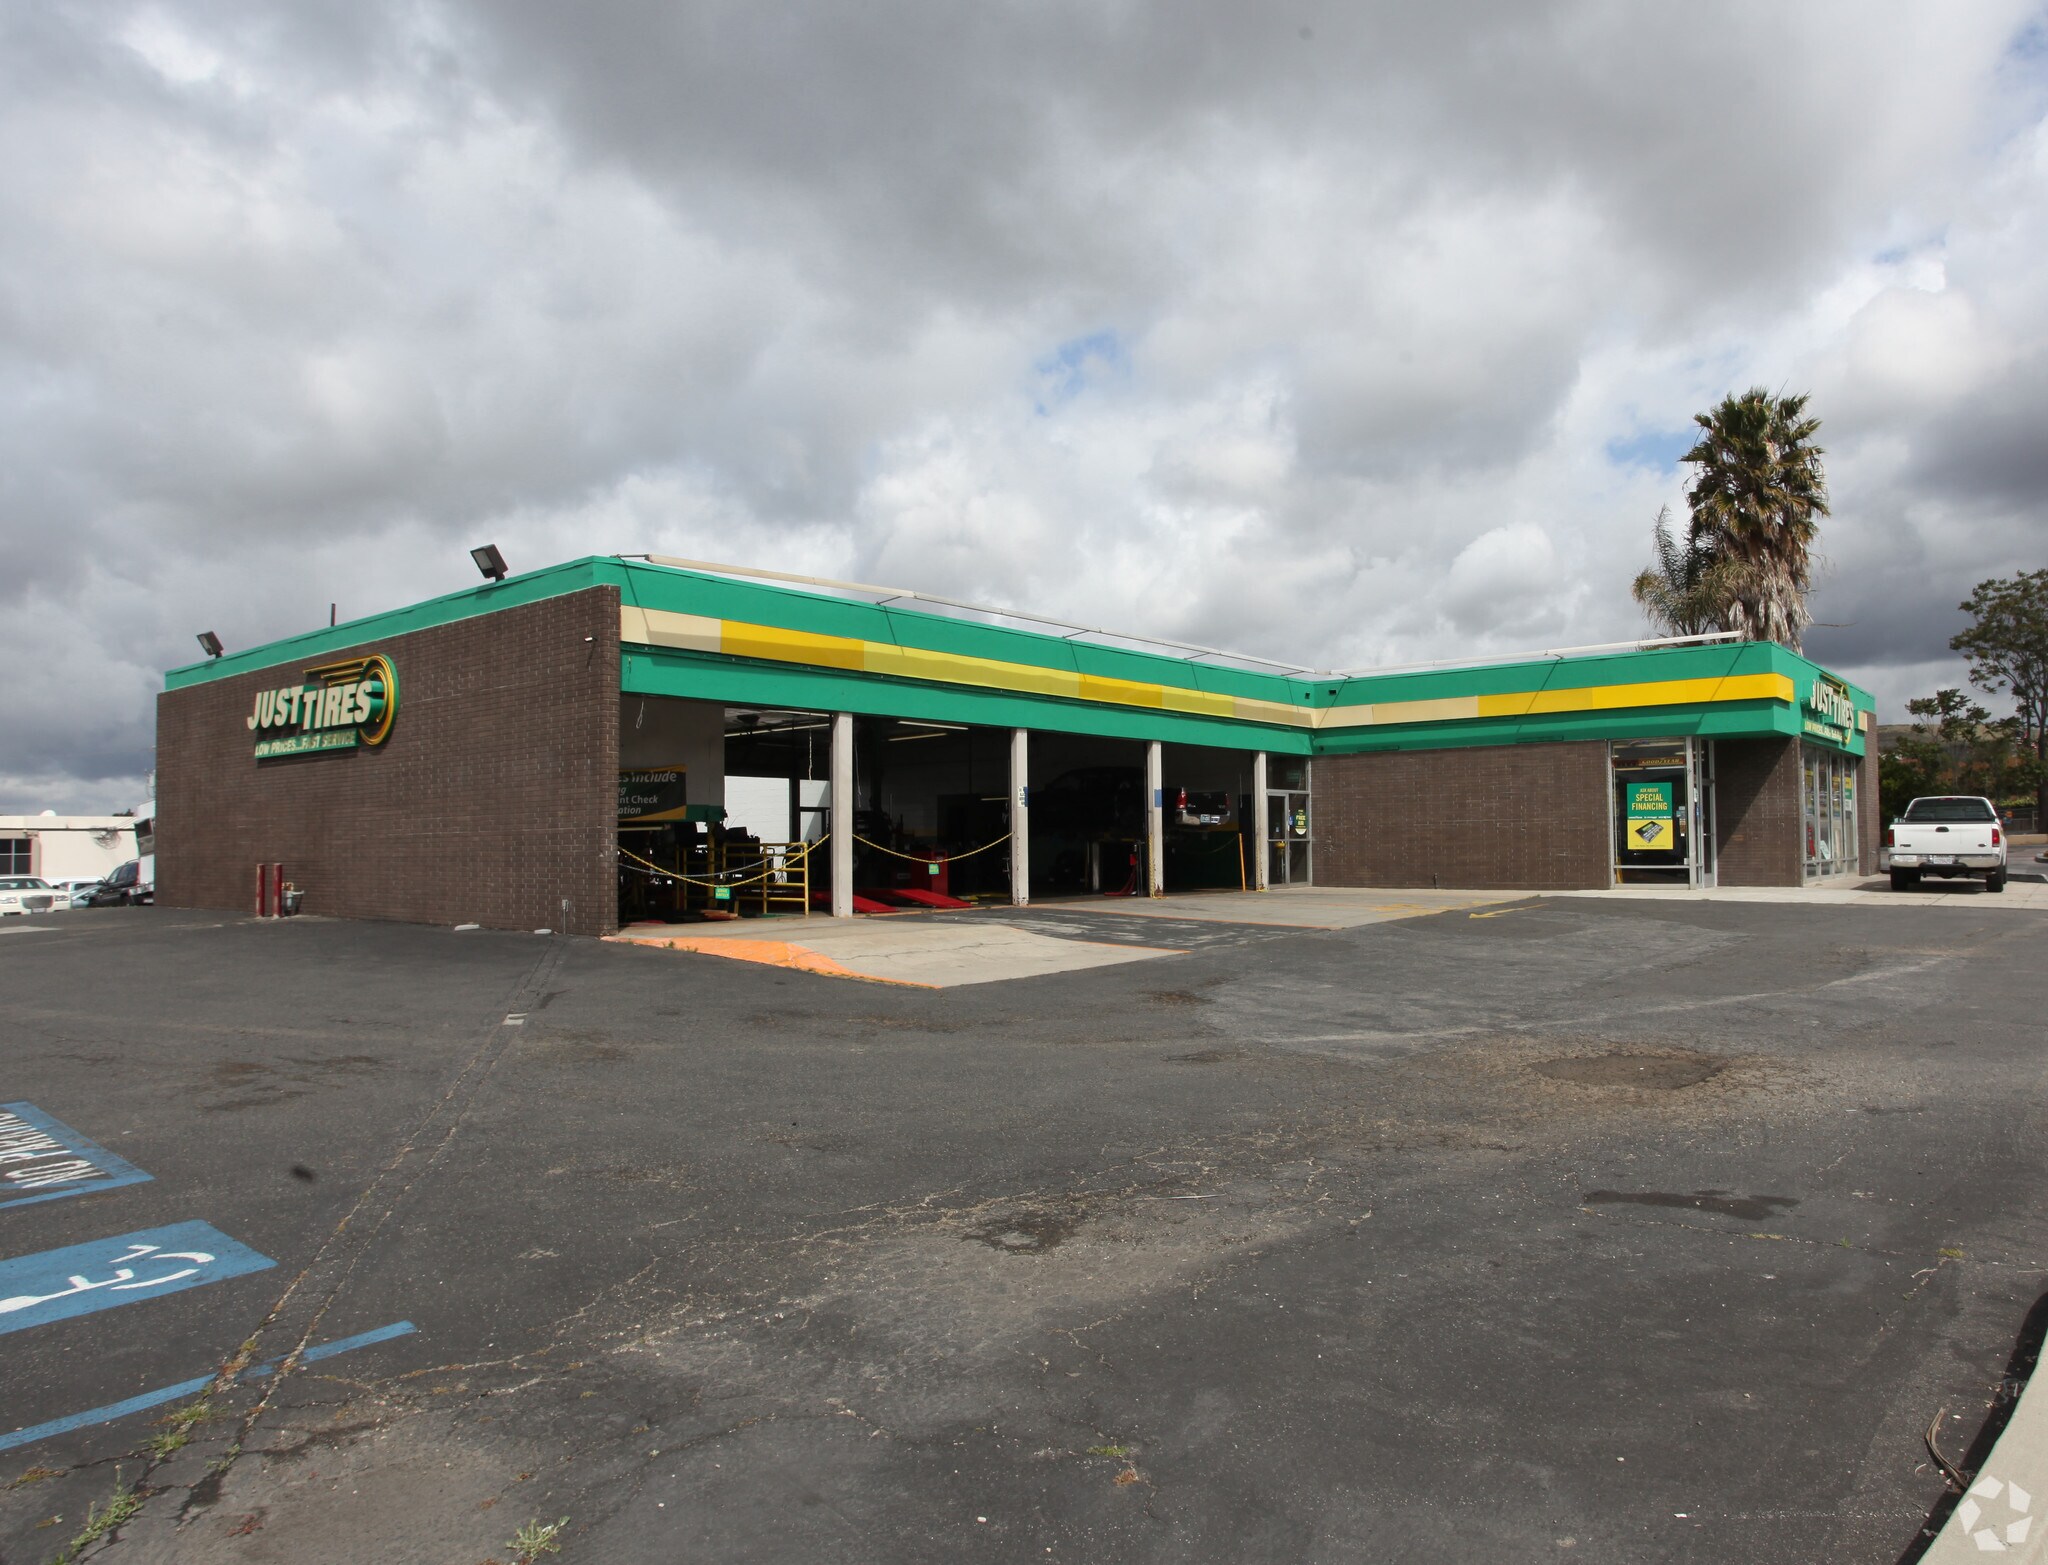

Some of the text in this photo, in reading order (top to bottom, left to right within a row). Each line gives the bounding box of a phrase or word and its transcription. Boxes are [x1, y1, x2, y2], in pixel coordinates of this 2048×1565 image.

[247, 680, 373, 730] JUST TIRES
[1809, 679, 1854, 730] JUST TIRES
[255, 743, 270, 756] LOW
[631, 771, 677, 783] include
[631, 795, 659, 804] Check
